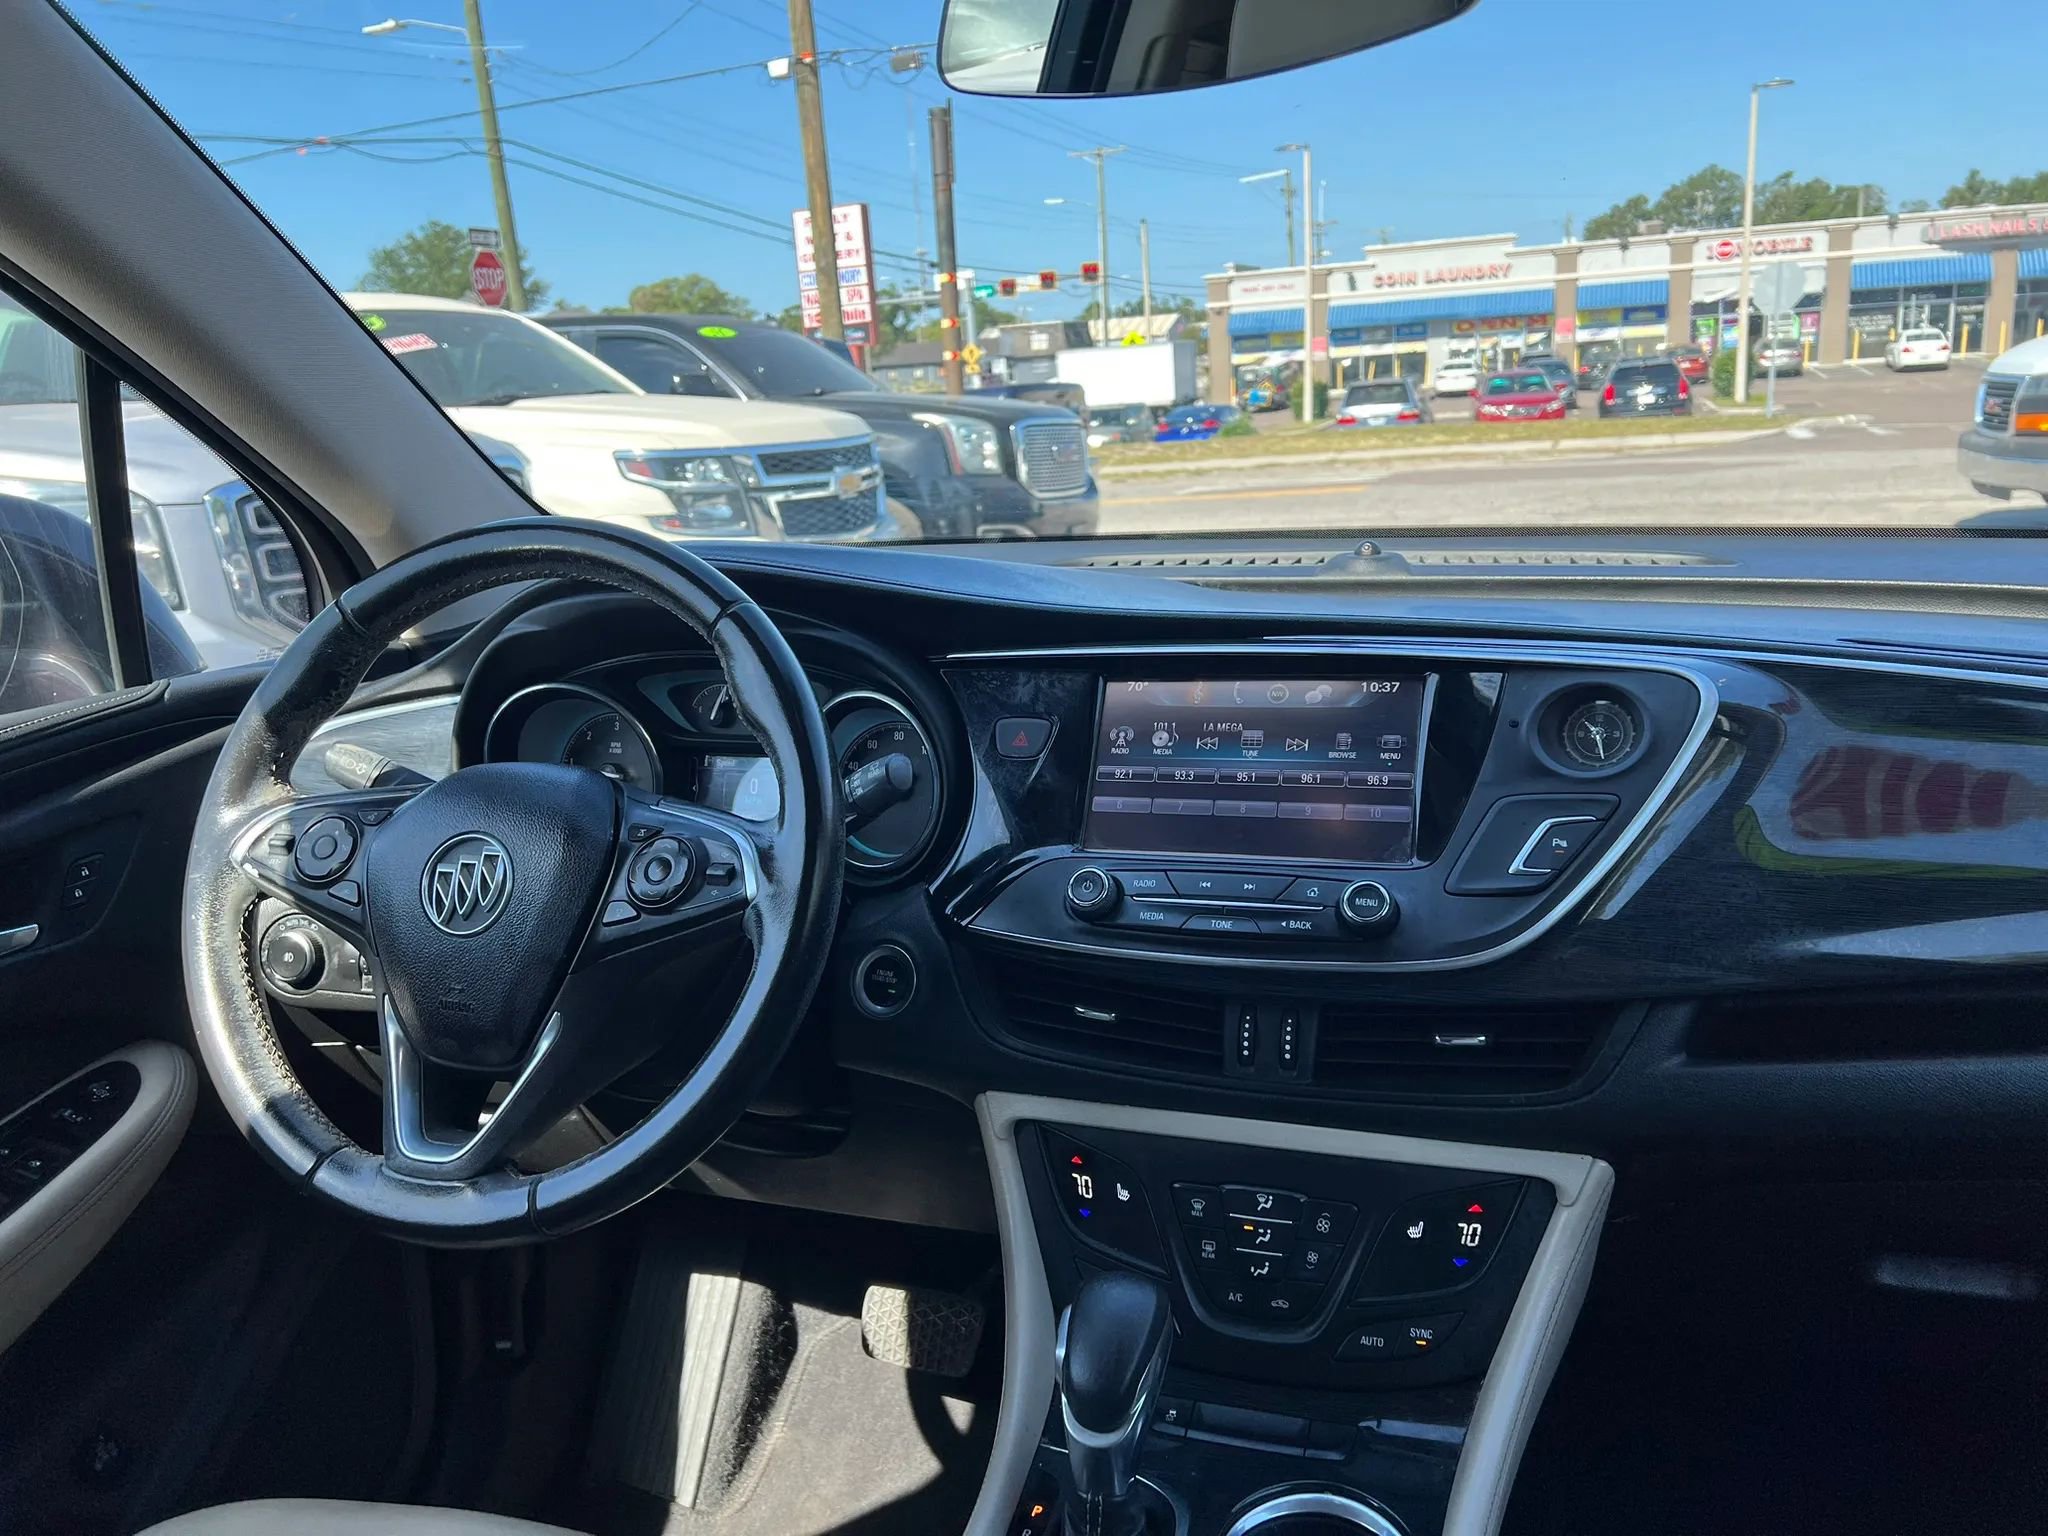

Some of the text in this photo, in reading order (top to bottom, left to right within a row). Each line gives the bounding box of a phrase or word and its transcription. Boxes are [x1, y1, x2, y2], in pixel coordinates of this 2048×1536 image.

[1989, 217, 2037, 236] NAILS
[474, 267, 504, 290] STOP
[1374, 263, 1513, 288] COIN LAUNDRY
[1361, 681, 1400, 693] 10:37
[614, 721, 620, 731] 3
[1203, 722, 1243, 733] LA MEGA
[586, 731, 592, 740] 2
[893, 731, 904, 741] 80
[867, 740, 878, 749] 60
[1110, 747, 1130, 755] RADIO
[1152, 748, 1173, 756] MEDIA
[1242, 749, 1259, 757] TUNE
[1328, 751, 1357, 759] BROWSE
[1380, 752, 1401, 760] MENU
[848, 761, 859, 771] 40
[1114, 769, 1133, 779] 92.1
[1174, 770, 1195, 780] 93.3
[1236, 771, 1256, 782] 95.1
[1300, 773, 1321, 784] 96.1
[1367, 775, 1389, 786] 96.9
[750, 778, 758, 794] 0
[1370, 807, 1382, 818] 10
[1133, 879, 1156, 888] RADIO
[1355, 898, 1378, 907] MENU
[1139, 911, 1164, 921] MEDIA
[1211, 920, 1233, 929] TONE
[1289, 920, 1312, 930] BACK
[1072, 1172, 1093, 1199] 70
[1458, 1222, 1482, 1247] 70
[1228, 1292, 1243, 1302] A/C
[1410, 1327, 1433, 1339] SYNC
[1360, 1336, 1384, 1348] AUTO
[1031, 1505, 1043, 1517] P
